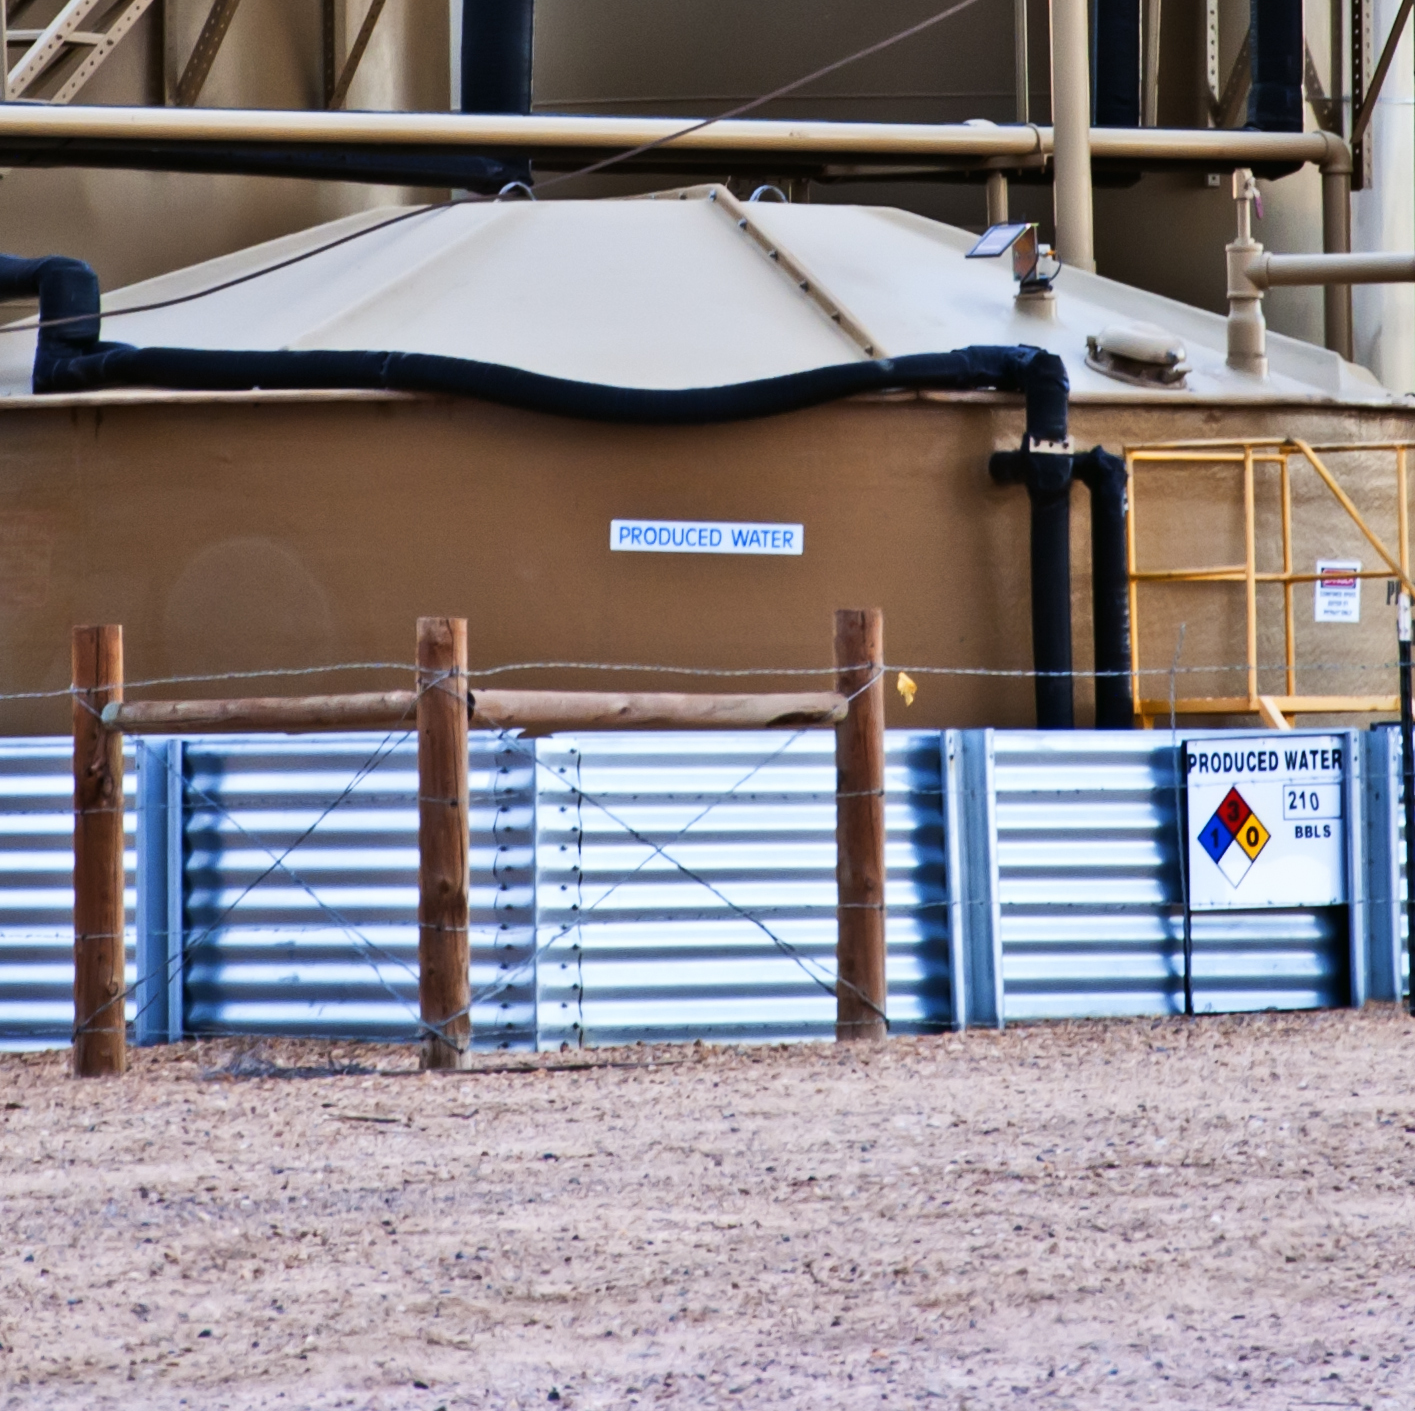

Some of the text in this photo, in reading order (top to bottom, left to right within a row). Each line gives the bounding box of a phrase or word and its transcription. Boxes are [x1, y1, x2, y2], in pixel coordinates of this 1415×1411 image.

[618, 526, 795, 549] PRODUCED WATER
[1188, 748, 1343, 774] PRODUCED WATER
[1227, 800, 1240, 822] 3
[1288, 791, 1320, 811] 210
[1210, 828, 1220, 848] 1
[1246, 826, 1260, 847] 0
[1295, 825, 1332, 839] BBLS
